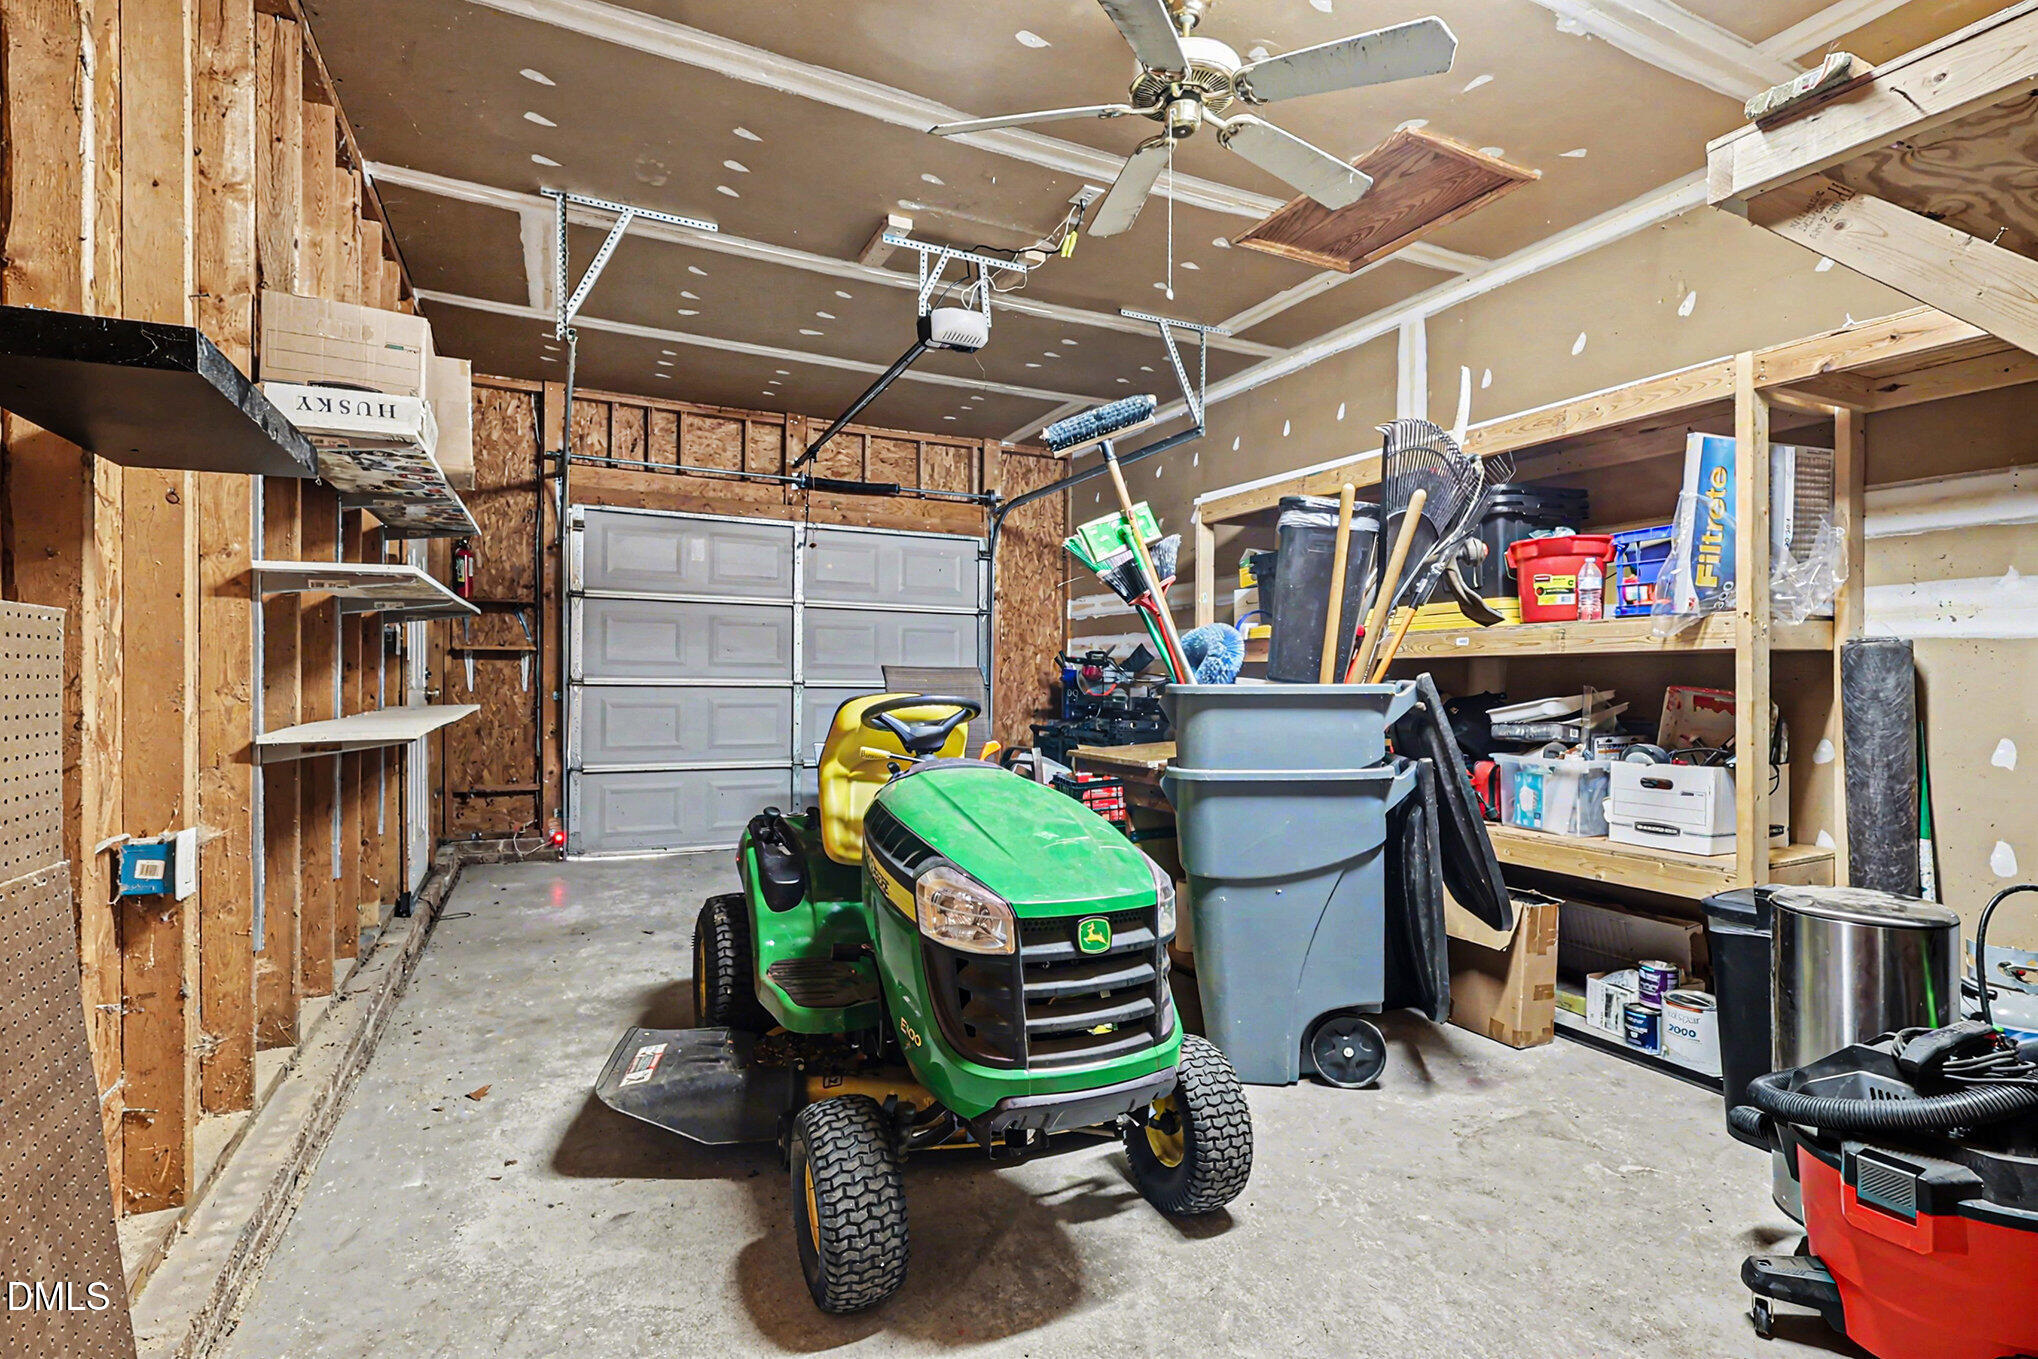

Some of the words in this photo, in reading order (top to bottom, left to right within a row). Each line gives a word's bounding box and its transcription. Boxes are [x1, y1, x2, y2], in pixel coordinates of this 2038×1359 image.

[296, 396, 396, 419] HUSKY
[1695, 466, 1728, 588] Filtrete
[901, 1016, 922, 1047] E100
